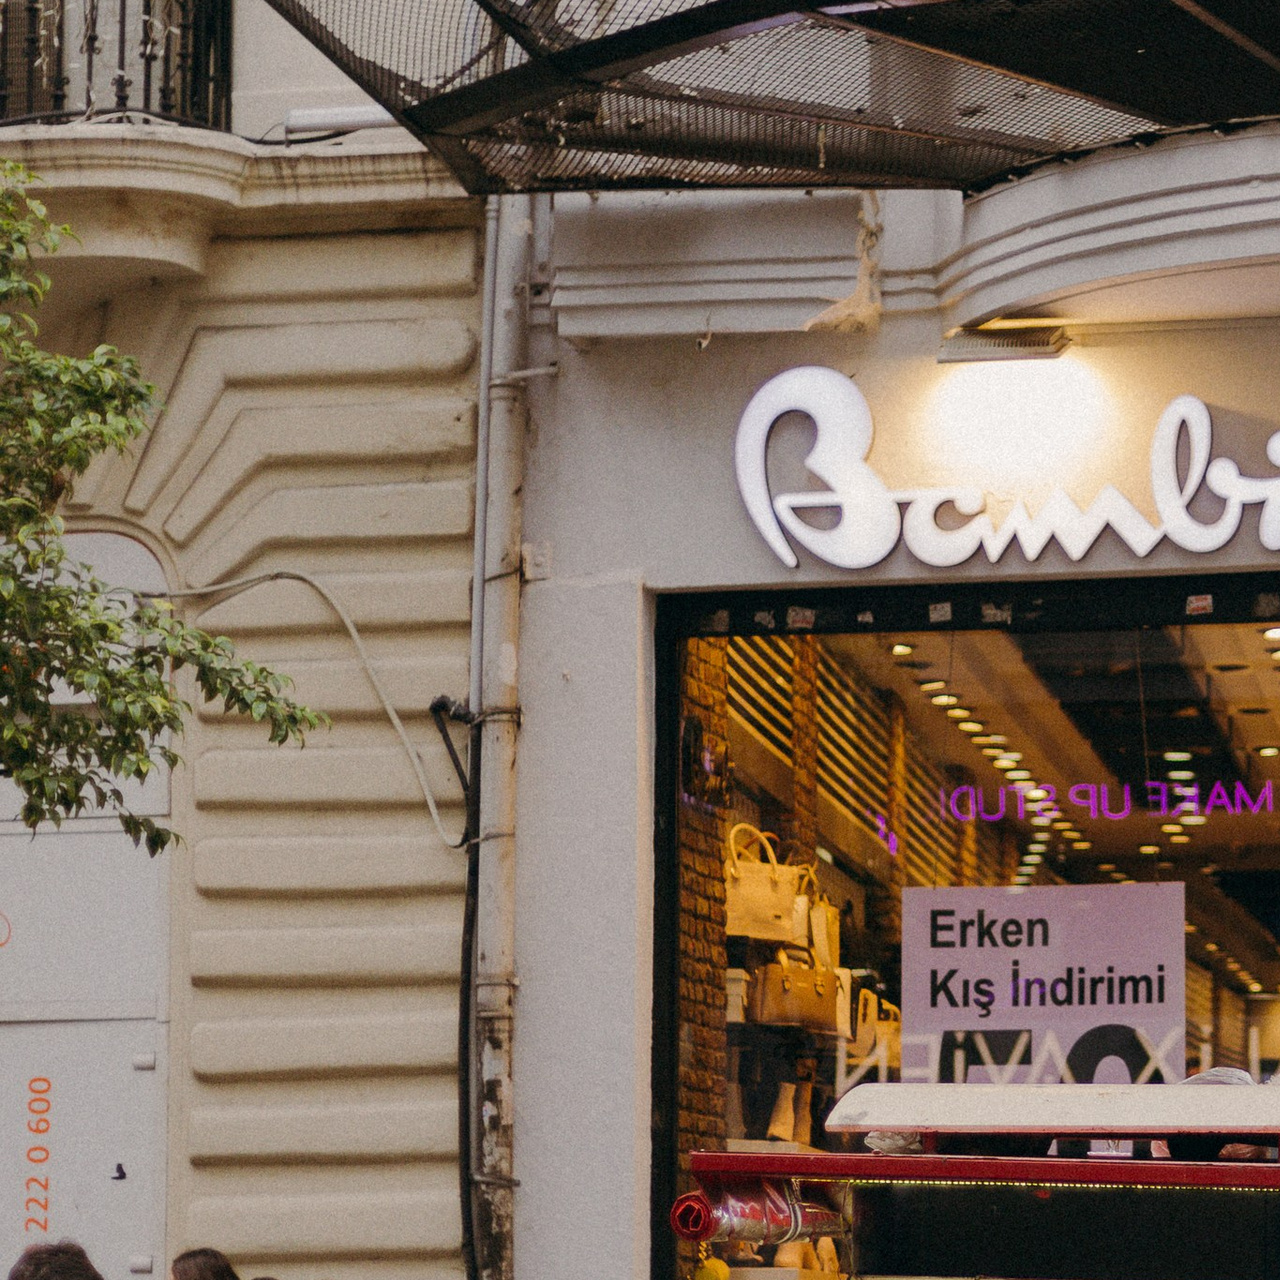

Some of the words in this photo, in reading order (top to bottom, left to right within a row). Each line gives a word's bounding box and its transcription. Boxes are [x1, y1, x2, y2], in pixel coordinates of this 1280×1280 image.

[930, 909, 1049, 948] Erken
[930, 969, 995, 1018] Kış
[1011, 959, 1165, 1007] İndirimi
[27, 1077, 51, 1134] 600
[25, 1177, 49, 1232] 222
